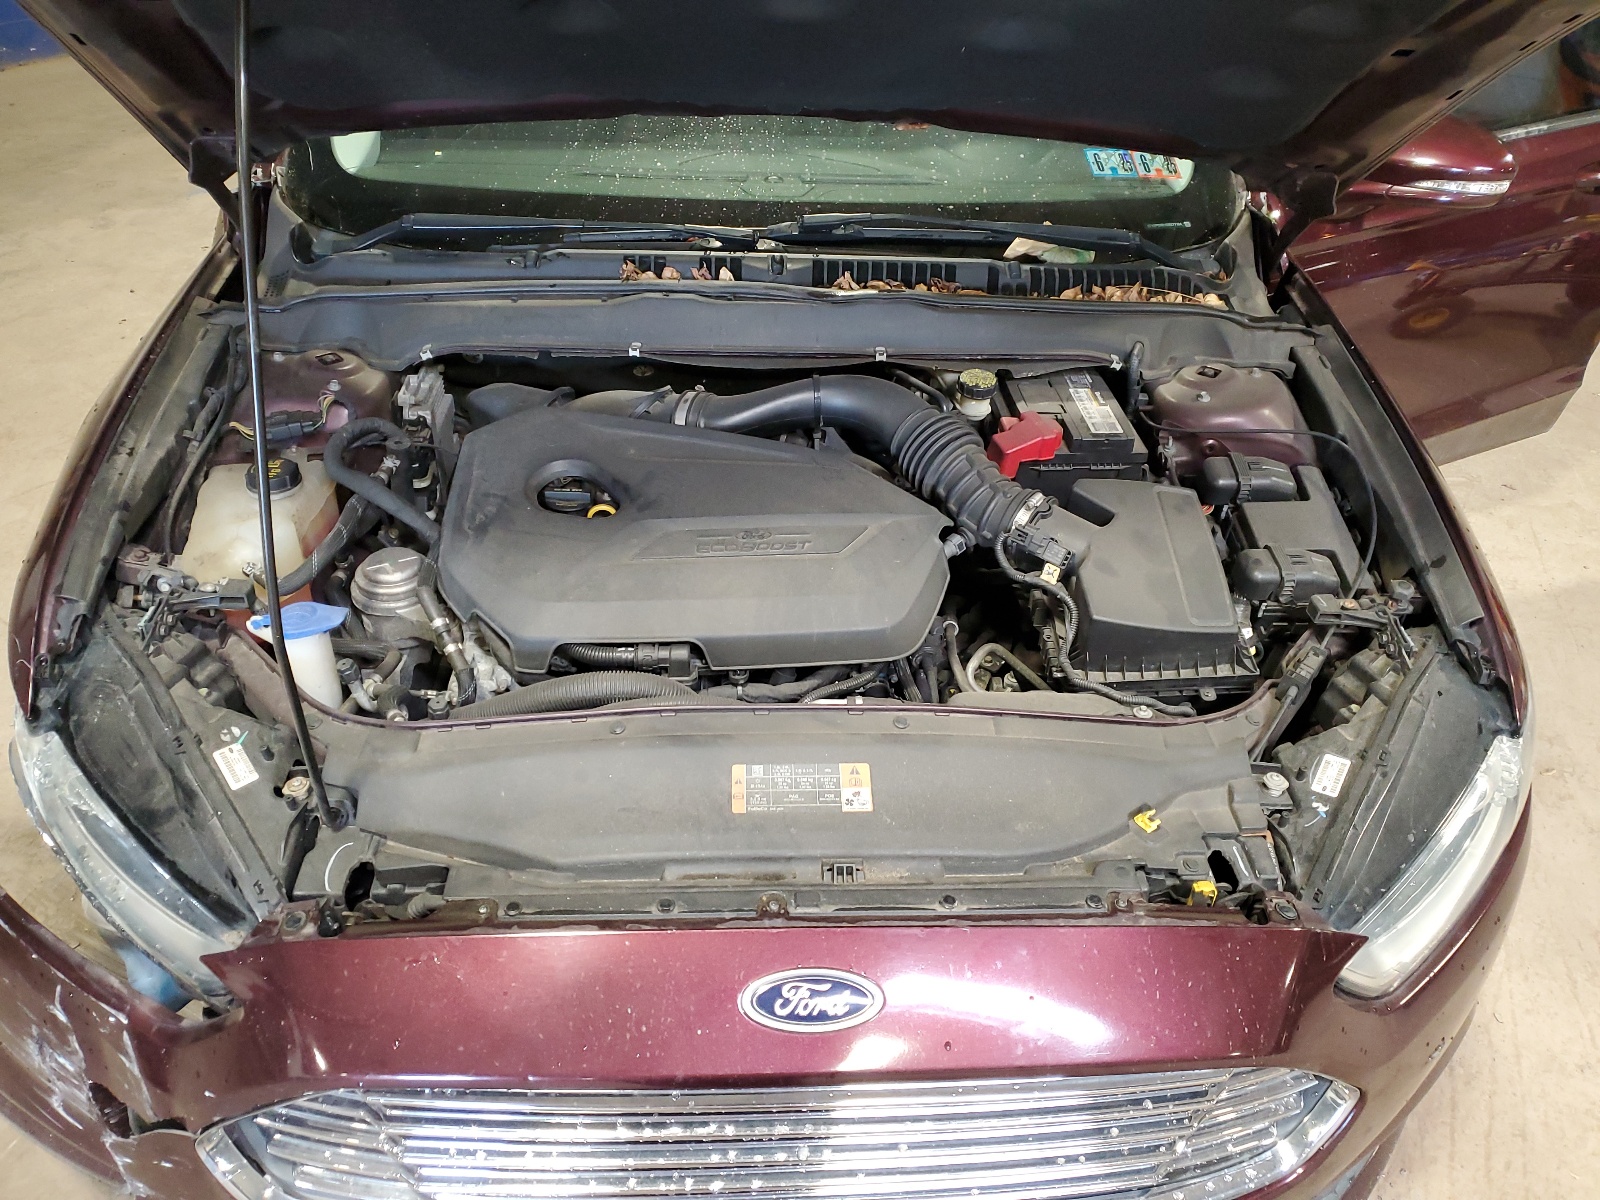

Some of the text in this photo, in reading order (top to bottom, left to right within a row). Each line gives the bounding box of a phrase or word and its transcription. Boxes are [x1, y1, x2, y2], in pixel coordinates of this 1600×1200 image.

[1093, 152, 1105, 172] 6
[1139, 154, 1151, 173] 6
[696, 540, 812, 554] ECOBOOST
[773, 981, 852, 1017] Ford
